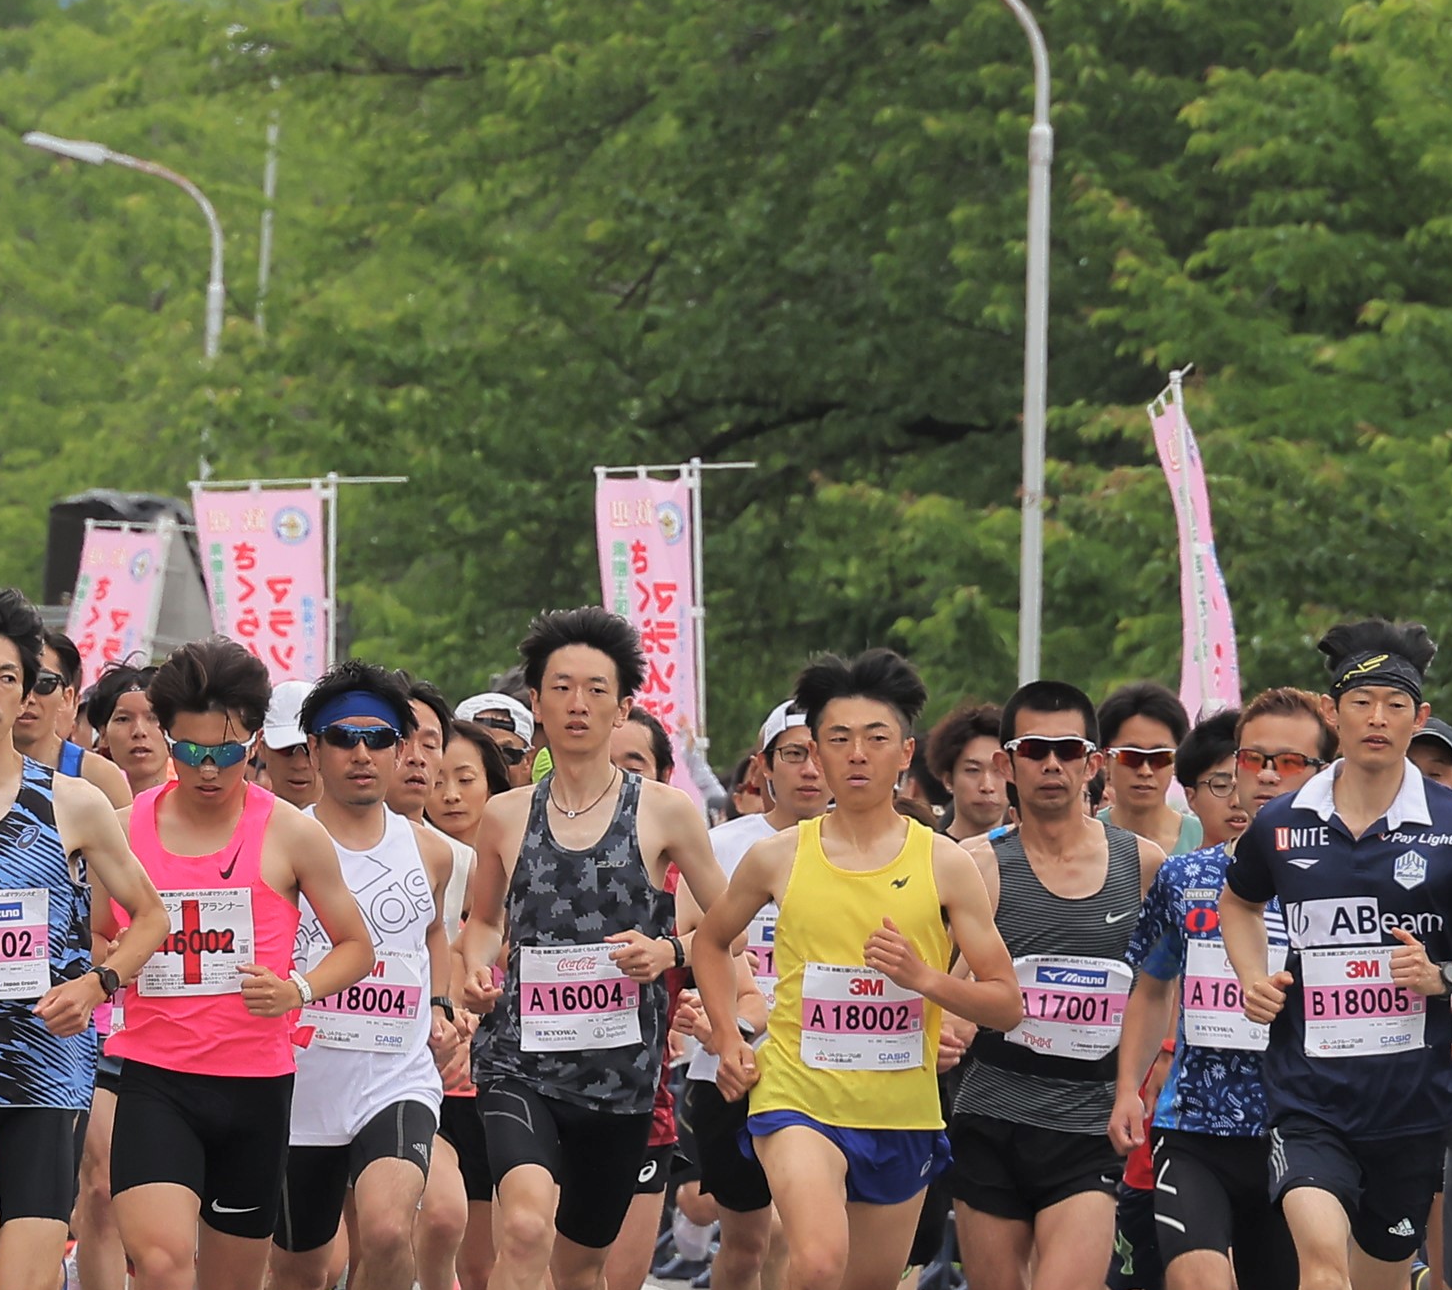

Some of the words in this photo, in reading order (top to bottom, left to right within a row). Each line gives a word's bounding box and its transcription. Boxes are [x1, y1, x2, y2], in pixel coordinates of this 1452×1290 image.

[1277, 826, 1330, 850] UNITE
[1391, 832, 1414, 845] Pay
[1330, 905, 1444, 937] ABeam
[369, 961, 386, 978] M
[1345, 959, 1380, 979] 3M
[529, 982, 624, 1012] A16004
[849, 978, 884, 997] 3M
[1312, 987, 1410, 1016] B18005
[809, 1004, 909, 1031] A18002
[375, 1034, 403, 1044] CASIO
[1380, 1034, 1412, 1044] CASIO
[878, 1051, 911, 1061] CASIO
